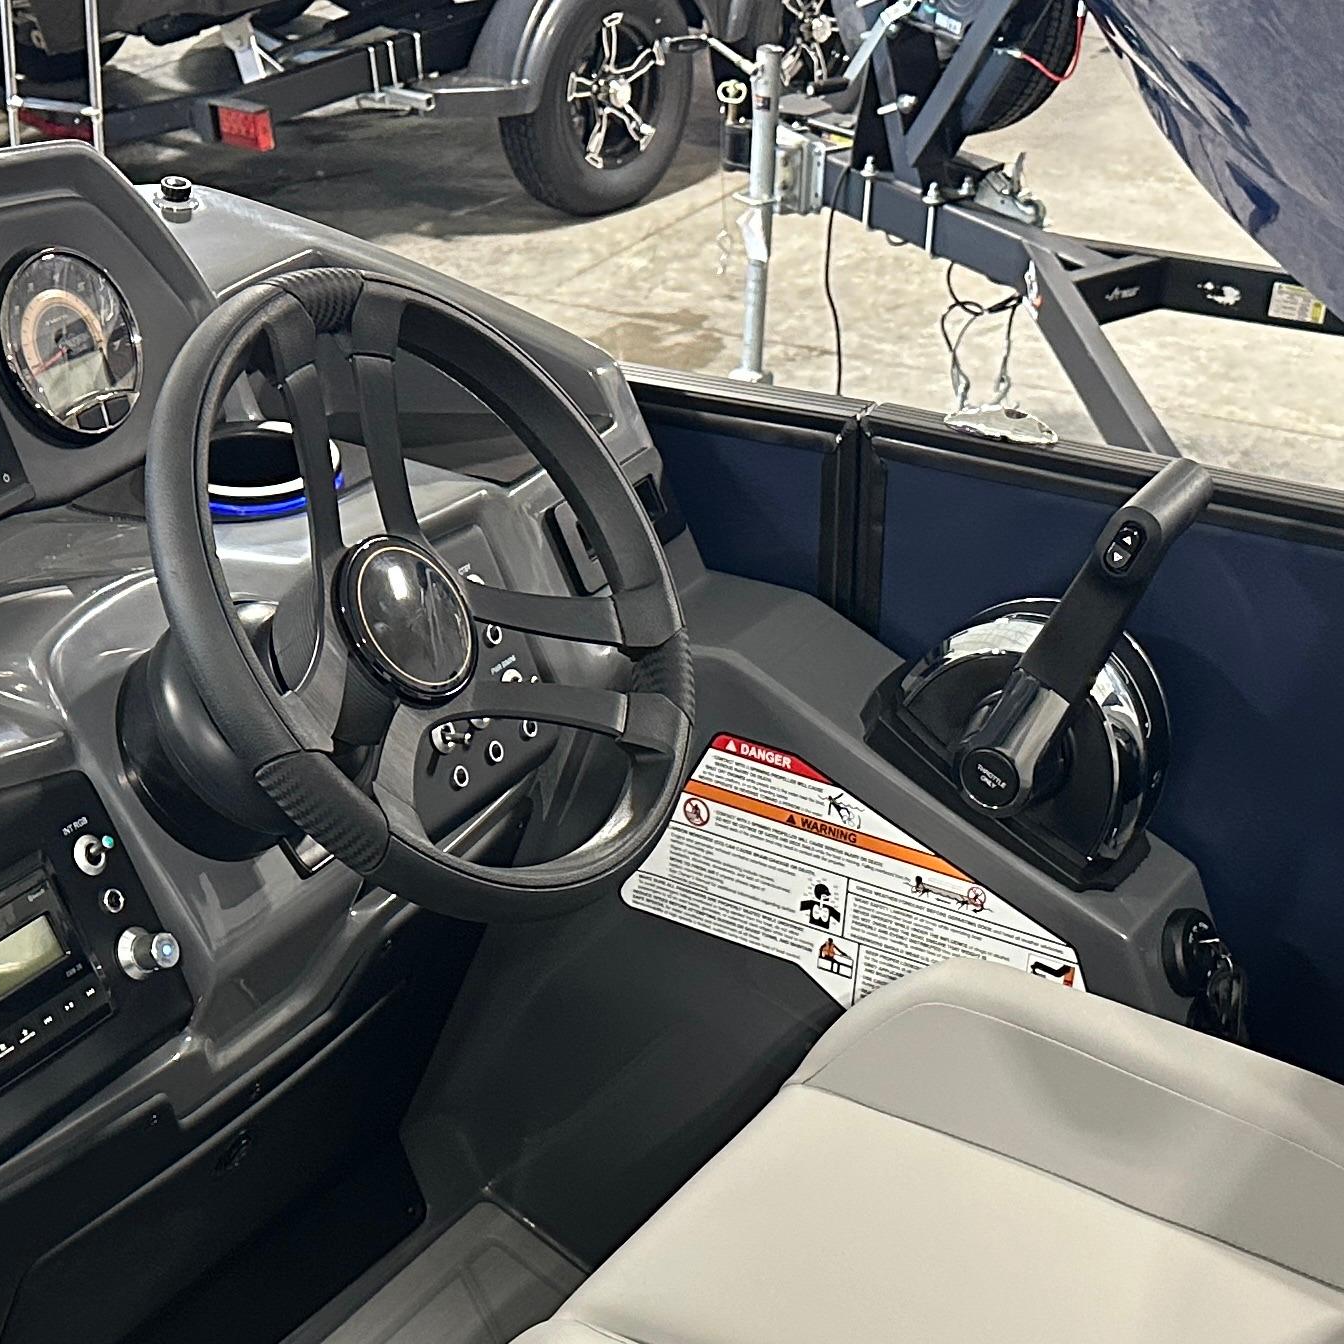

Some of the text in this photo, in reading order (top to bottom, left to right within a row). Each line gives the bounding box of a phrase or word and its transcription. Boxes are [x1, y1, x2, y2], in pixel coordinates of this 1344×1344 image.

[740, 743, 792, 770] DANGER
[977, 763, 1007, 789] THROTTLE
[980, 775, 997, 789] ONLY
[800, 817, 858, 844] WARNING
